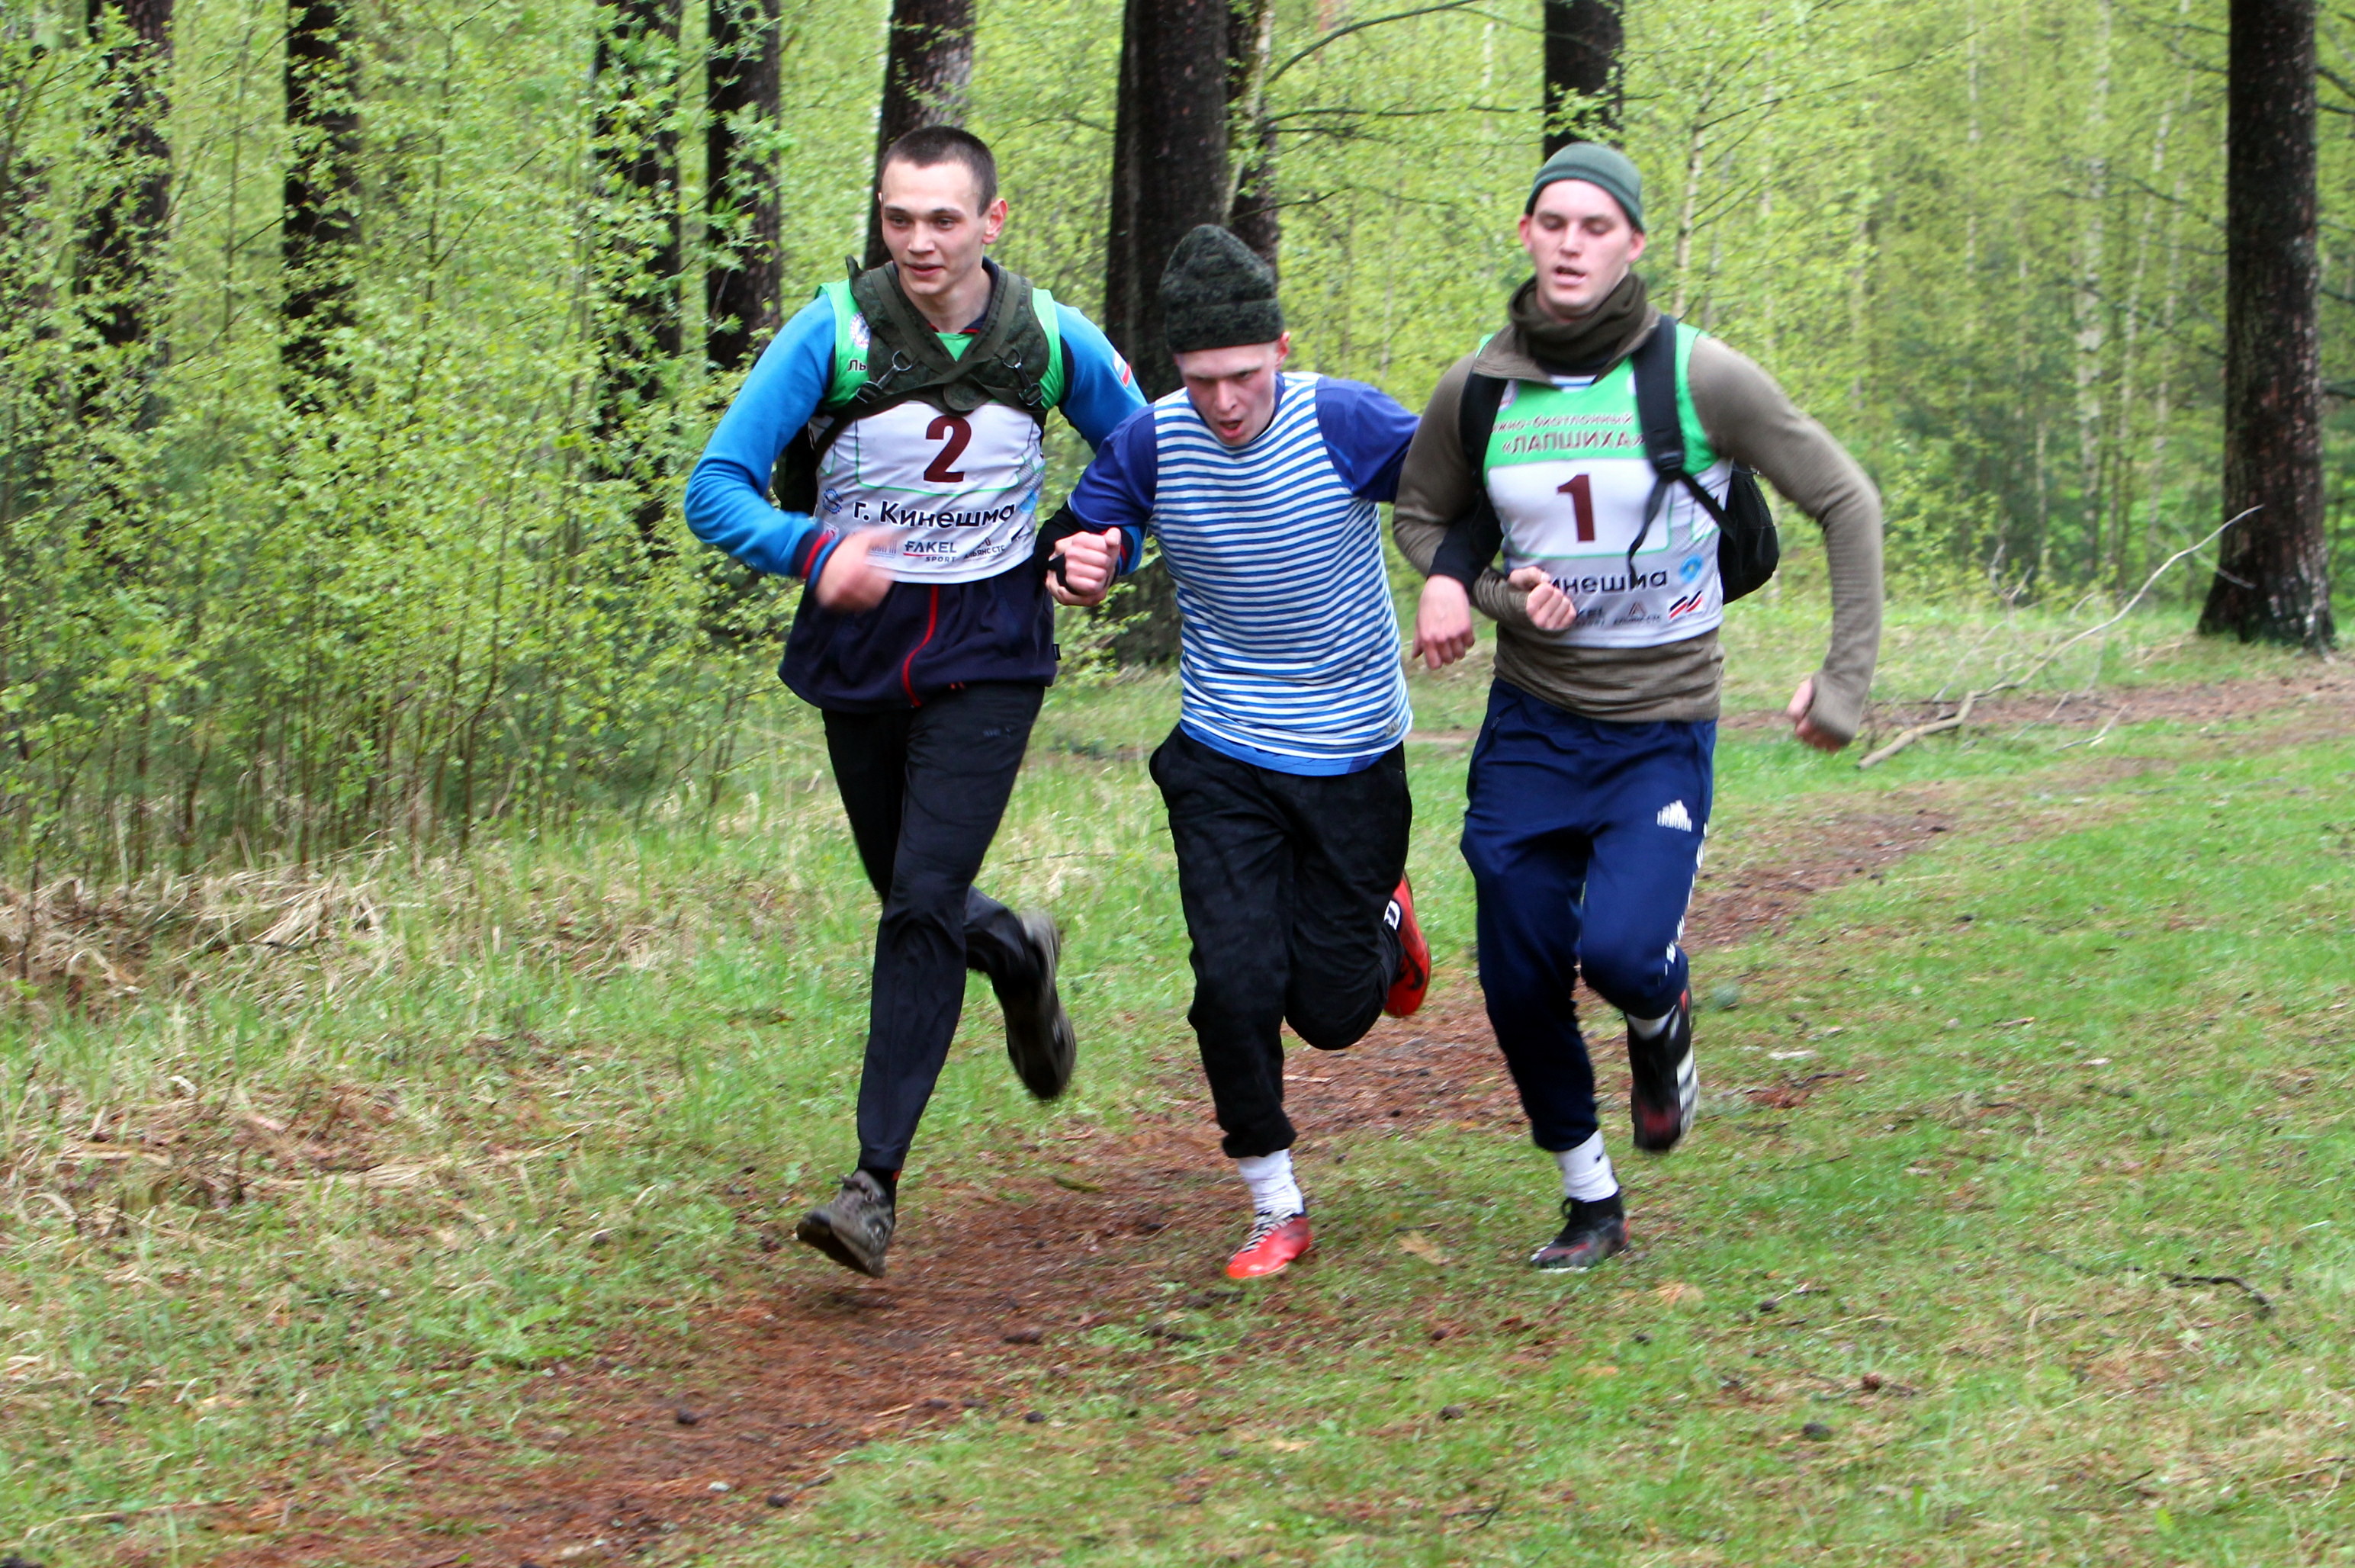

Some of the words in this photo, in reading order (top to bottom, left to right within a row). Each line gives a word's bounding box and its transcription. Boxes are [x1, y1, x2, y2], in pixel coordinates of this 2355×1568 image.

[923, 414, 972, 484] 2
[880, 500, 1016, 528] Кинешма
[1556, 473, 1595, 542] 1
[904, 540, 957, 553] FAKEL
